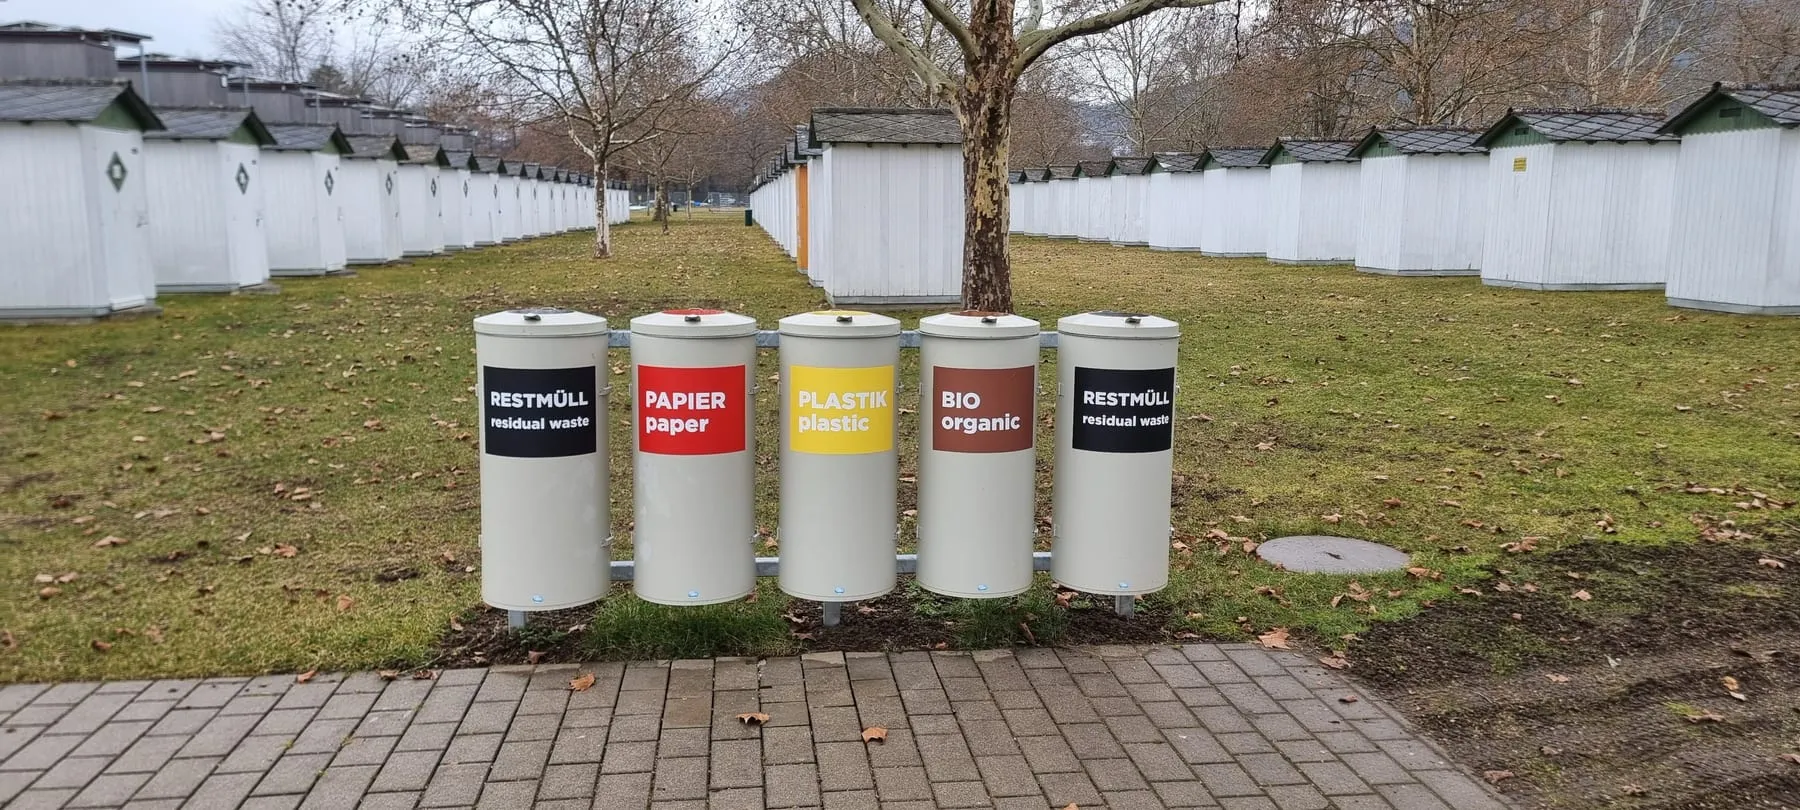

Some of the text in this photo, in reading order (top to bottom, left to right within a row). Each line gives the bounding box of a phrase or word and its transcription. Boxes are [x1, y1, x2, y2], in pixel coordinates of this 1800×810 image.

[490, 389, 589, 408] RESTMÜLL
[645, 390, 726, 410] PAPIER
[798, 390, 888, 410] PLASTIK
[942, 390, 980, 410] BIO
[1083, 389, 1170, 407] RESTMÜLL
[490, 416, 590, 430] residual waste
[645, 416, 709, 436] paper
[798, 413, 870, 433] plastic
[941, 413, 1020, 435] organic
[1082, 414, 1170, 427] residual waste
